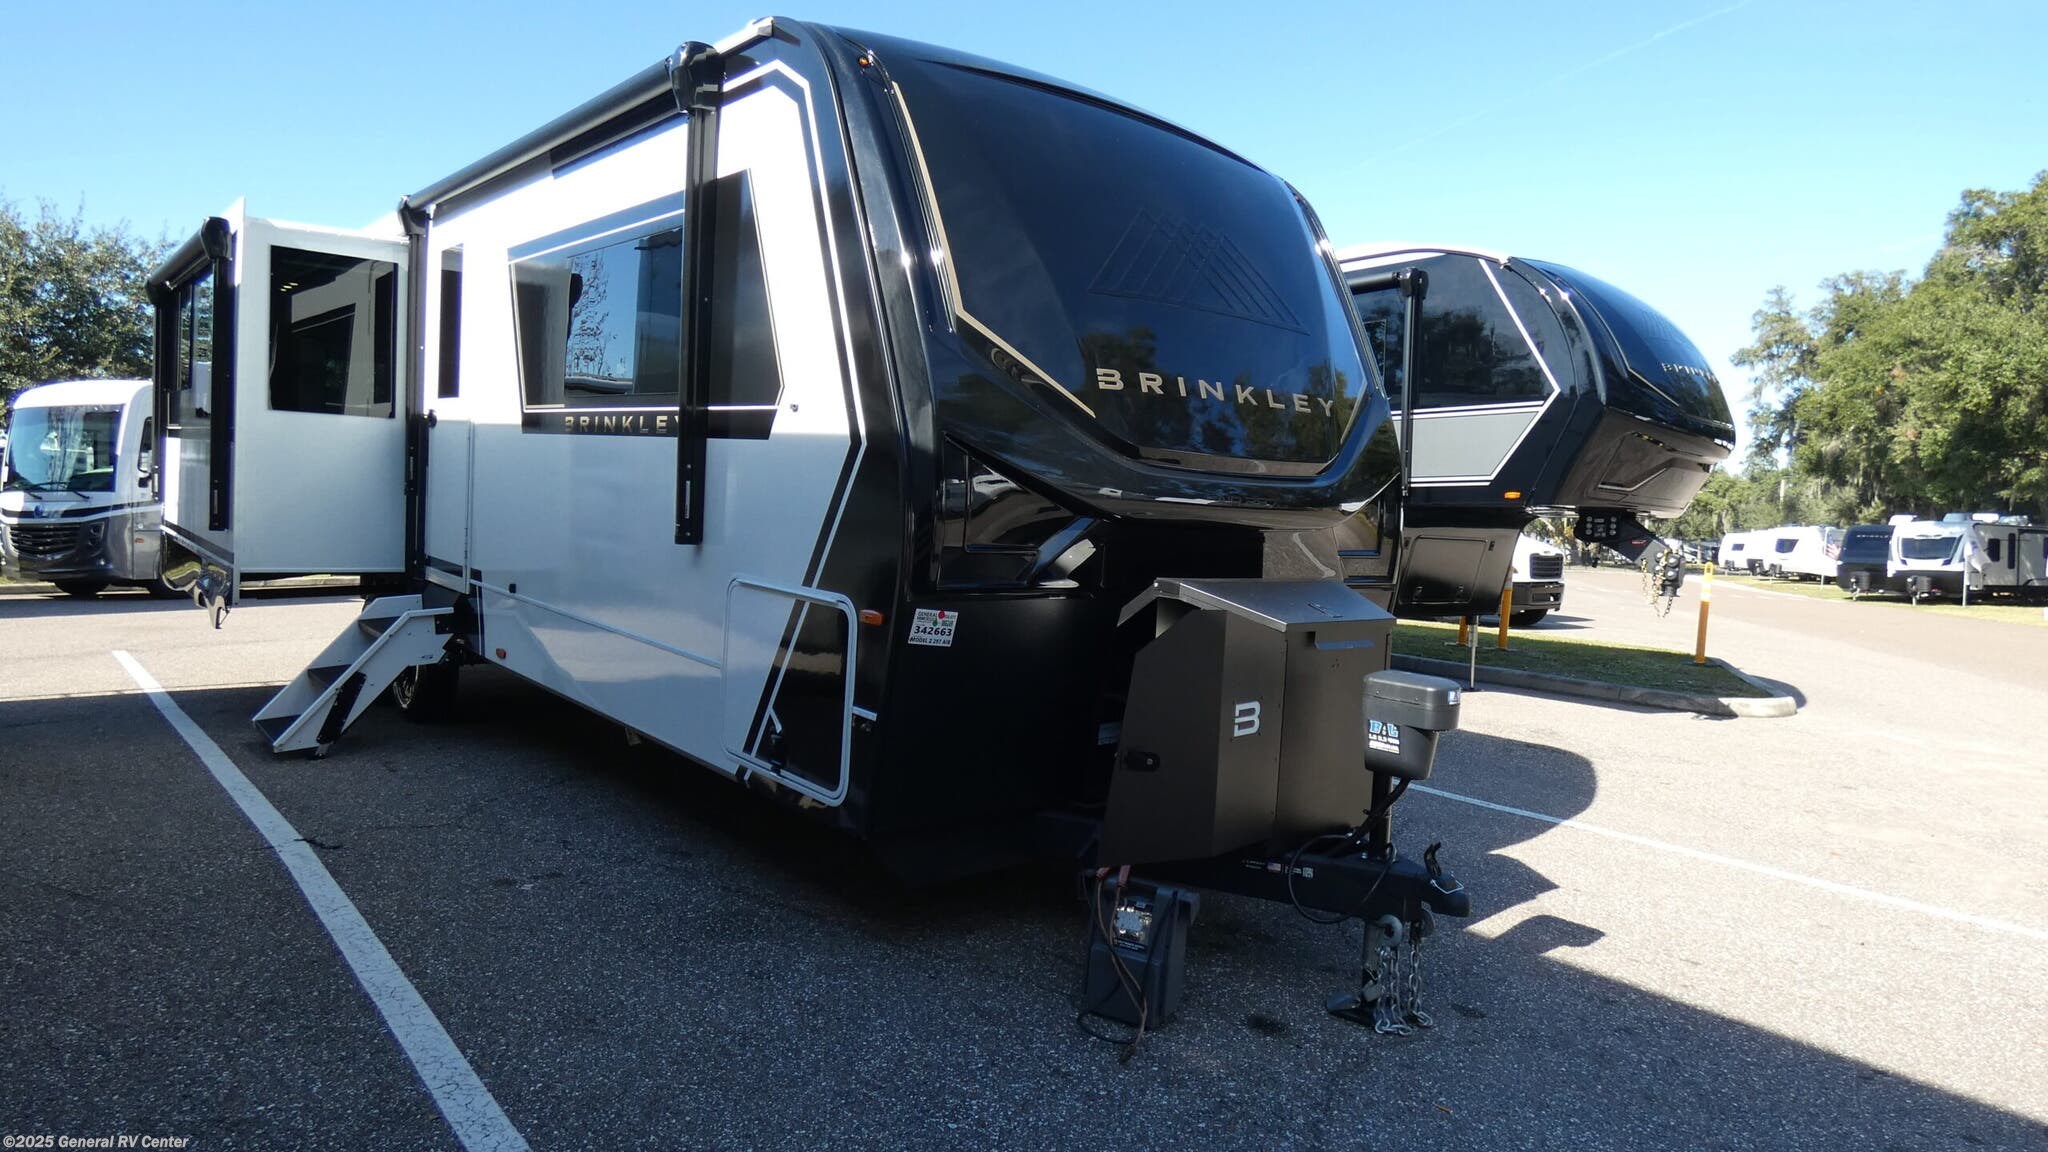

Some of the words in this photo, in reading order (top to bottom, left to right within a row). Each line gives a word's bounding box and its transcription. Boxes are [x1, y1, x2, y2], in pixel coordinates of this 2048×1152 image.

[1096, 368, 1333, 417] BRINKLEY
[914, 626, 952, 636] 342663
[1234, 701, 1260, 737] B
